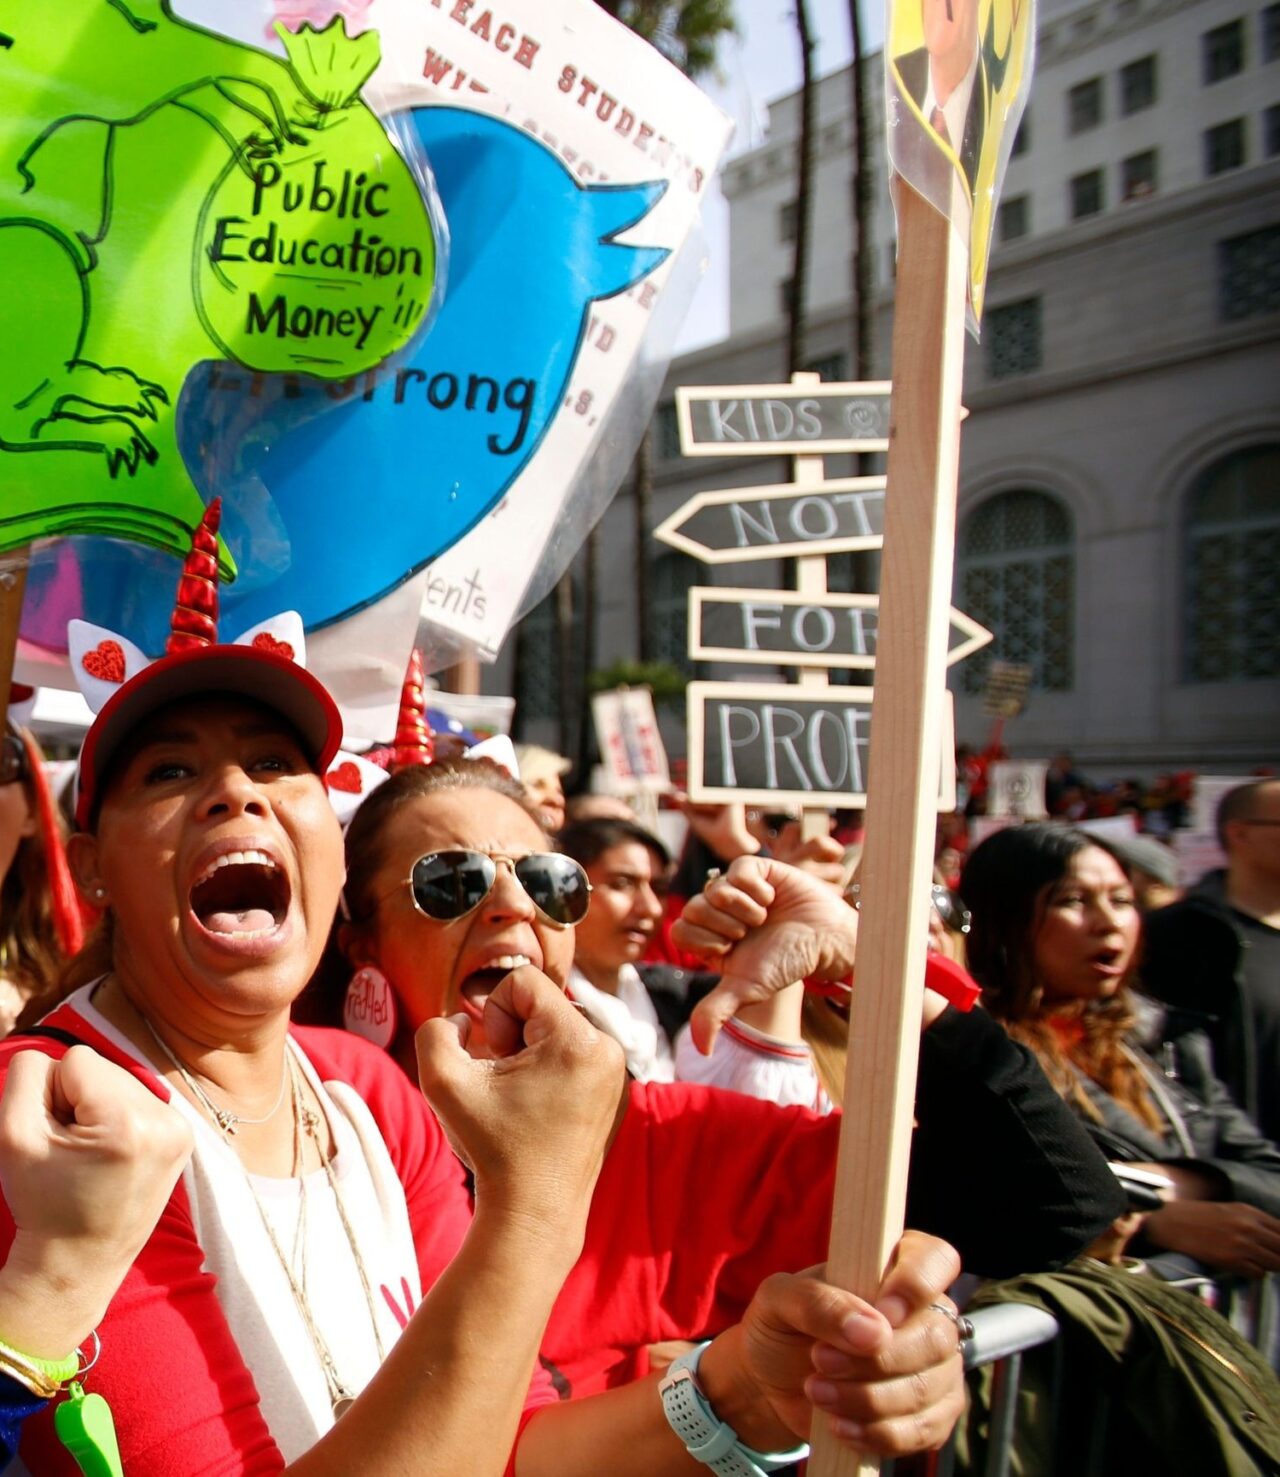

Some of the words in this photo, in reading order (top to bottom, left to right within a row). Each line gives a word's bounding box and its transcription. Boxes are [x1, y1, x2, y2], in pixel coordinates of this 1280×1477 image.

[431, 0, 541, 70] EACH
[252, 160, 390, 218] Public
[210, 215, 423, 279] Education
[708, 400, 823, 442] KIDS
[730, 489, 886, 548] NOT
[719, 704, 874, 793] PROF
